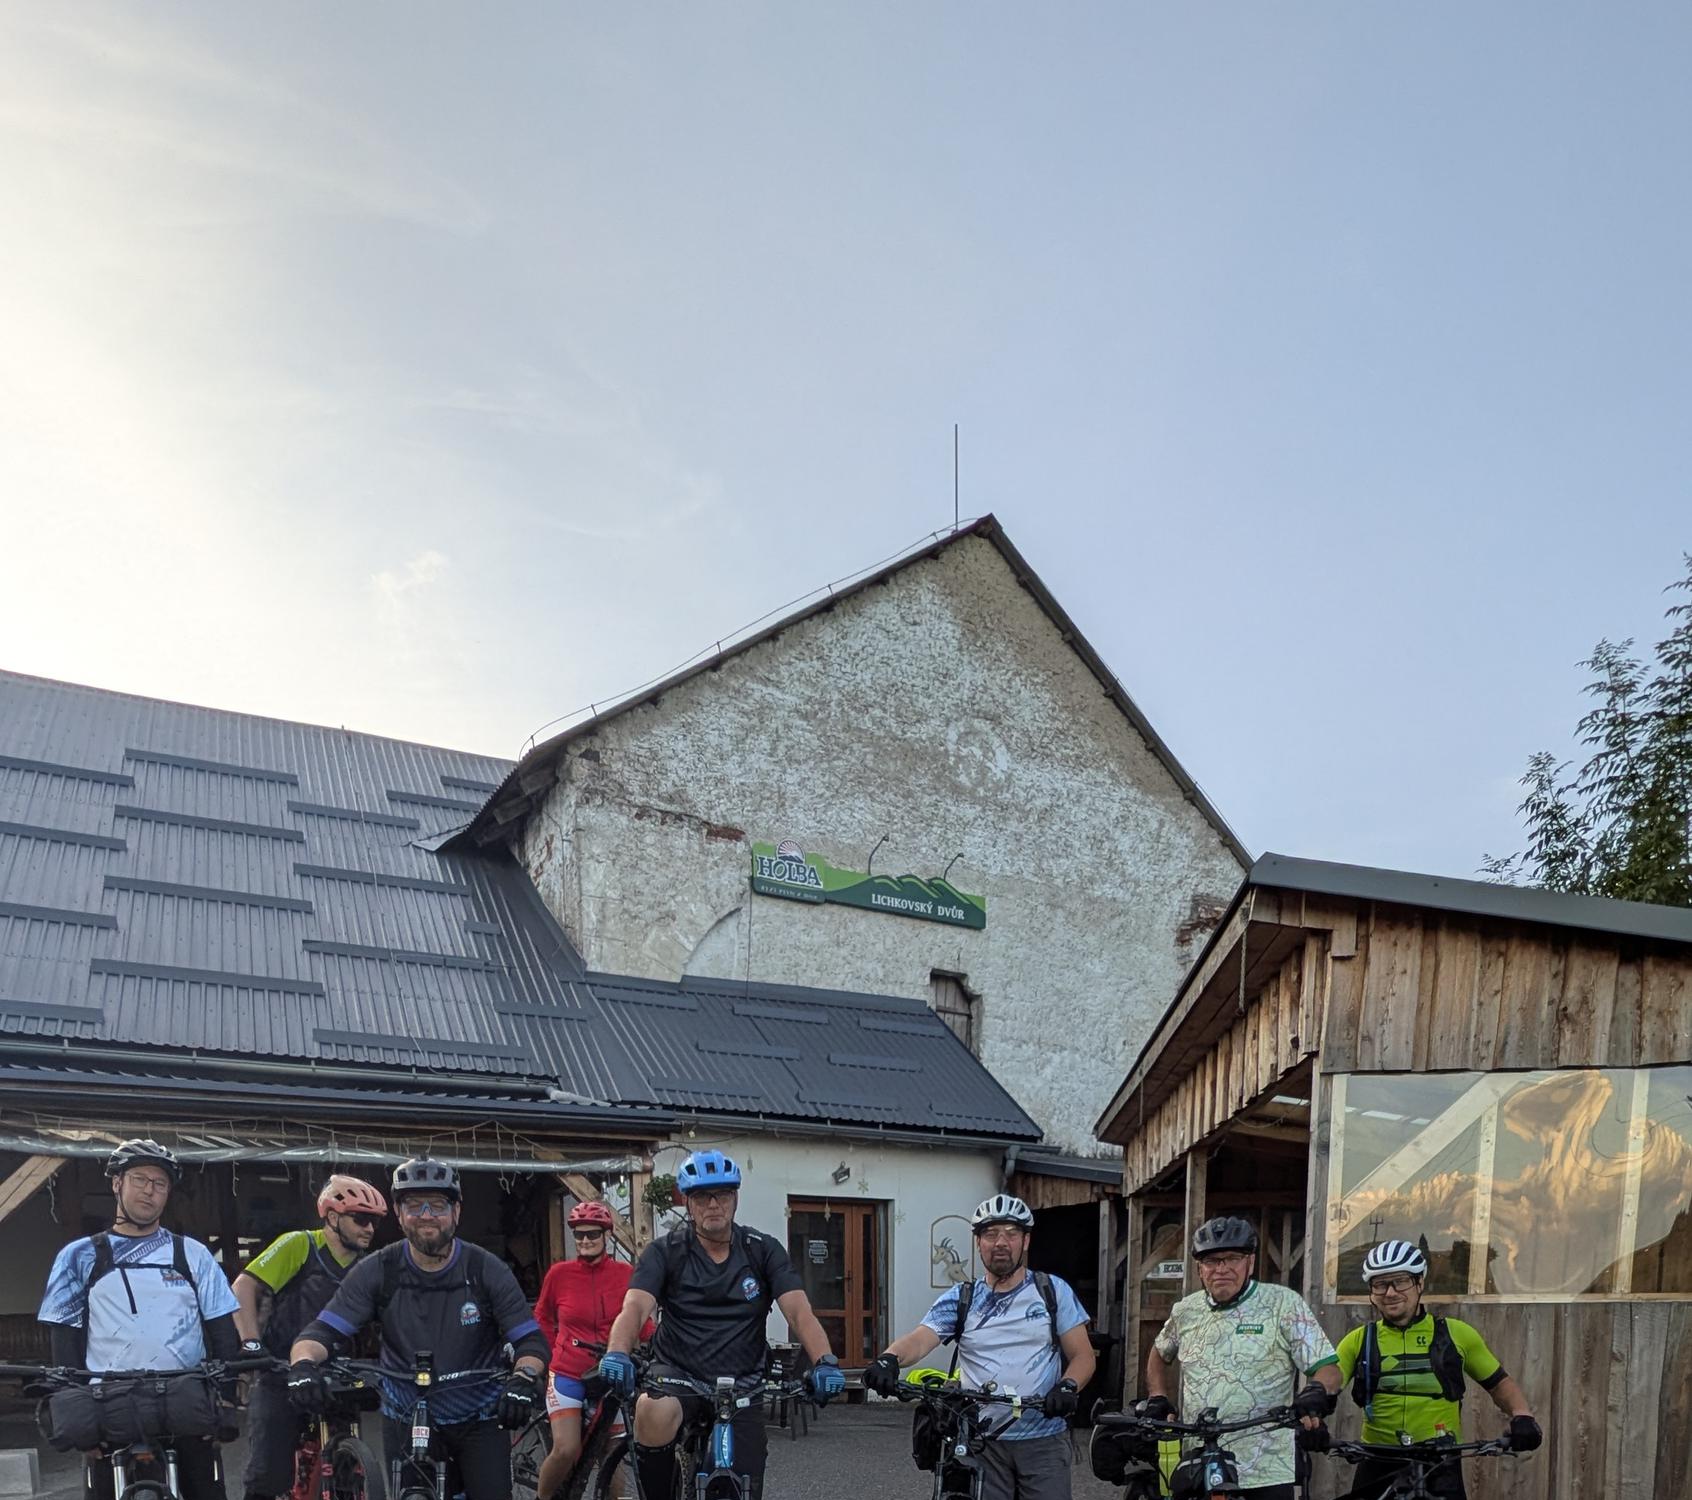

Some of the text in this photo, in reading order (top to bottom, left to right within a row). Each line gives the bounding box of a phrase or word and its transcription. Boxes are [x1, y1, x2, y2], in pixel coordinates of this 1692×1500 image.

[756, 855, 823, 888] HOLBA
[871, 893, 965, 920] LICHKOVSKÝ DVŮR
